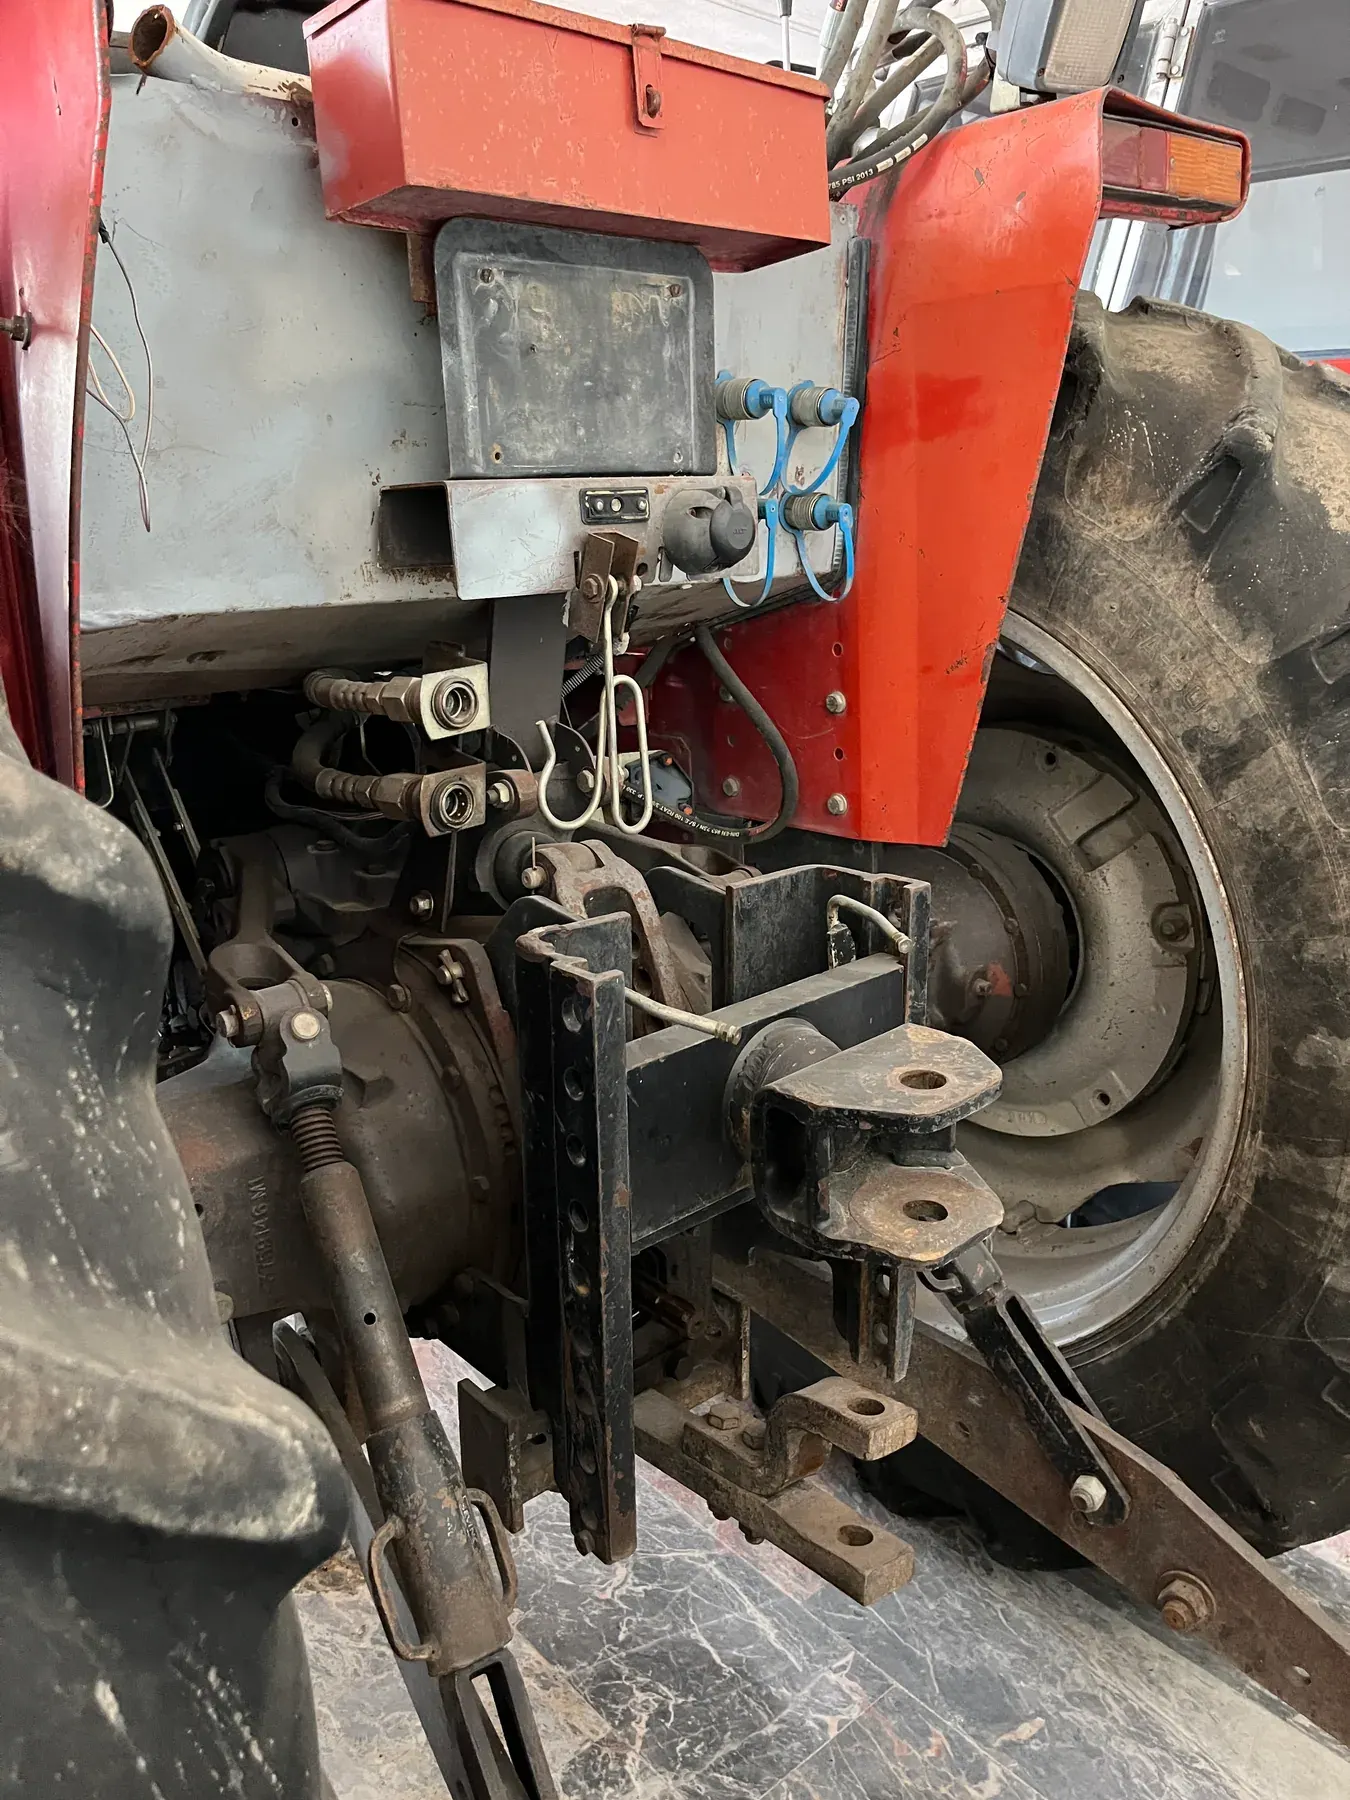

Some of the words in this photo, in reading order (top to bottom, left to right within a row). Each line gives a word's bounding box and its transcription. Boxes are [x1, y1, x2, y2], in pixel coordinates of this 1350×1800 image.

[842, 177, 855, 185] PSI
[856, 169, 873, 180] 2013
[674, 813, 684, 821] 100
